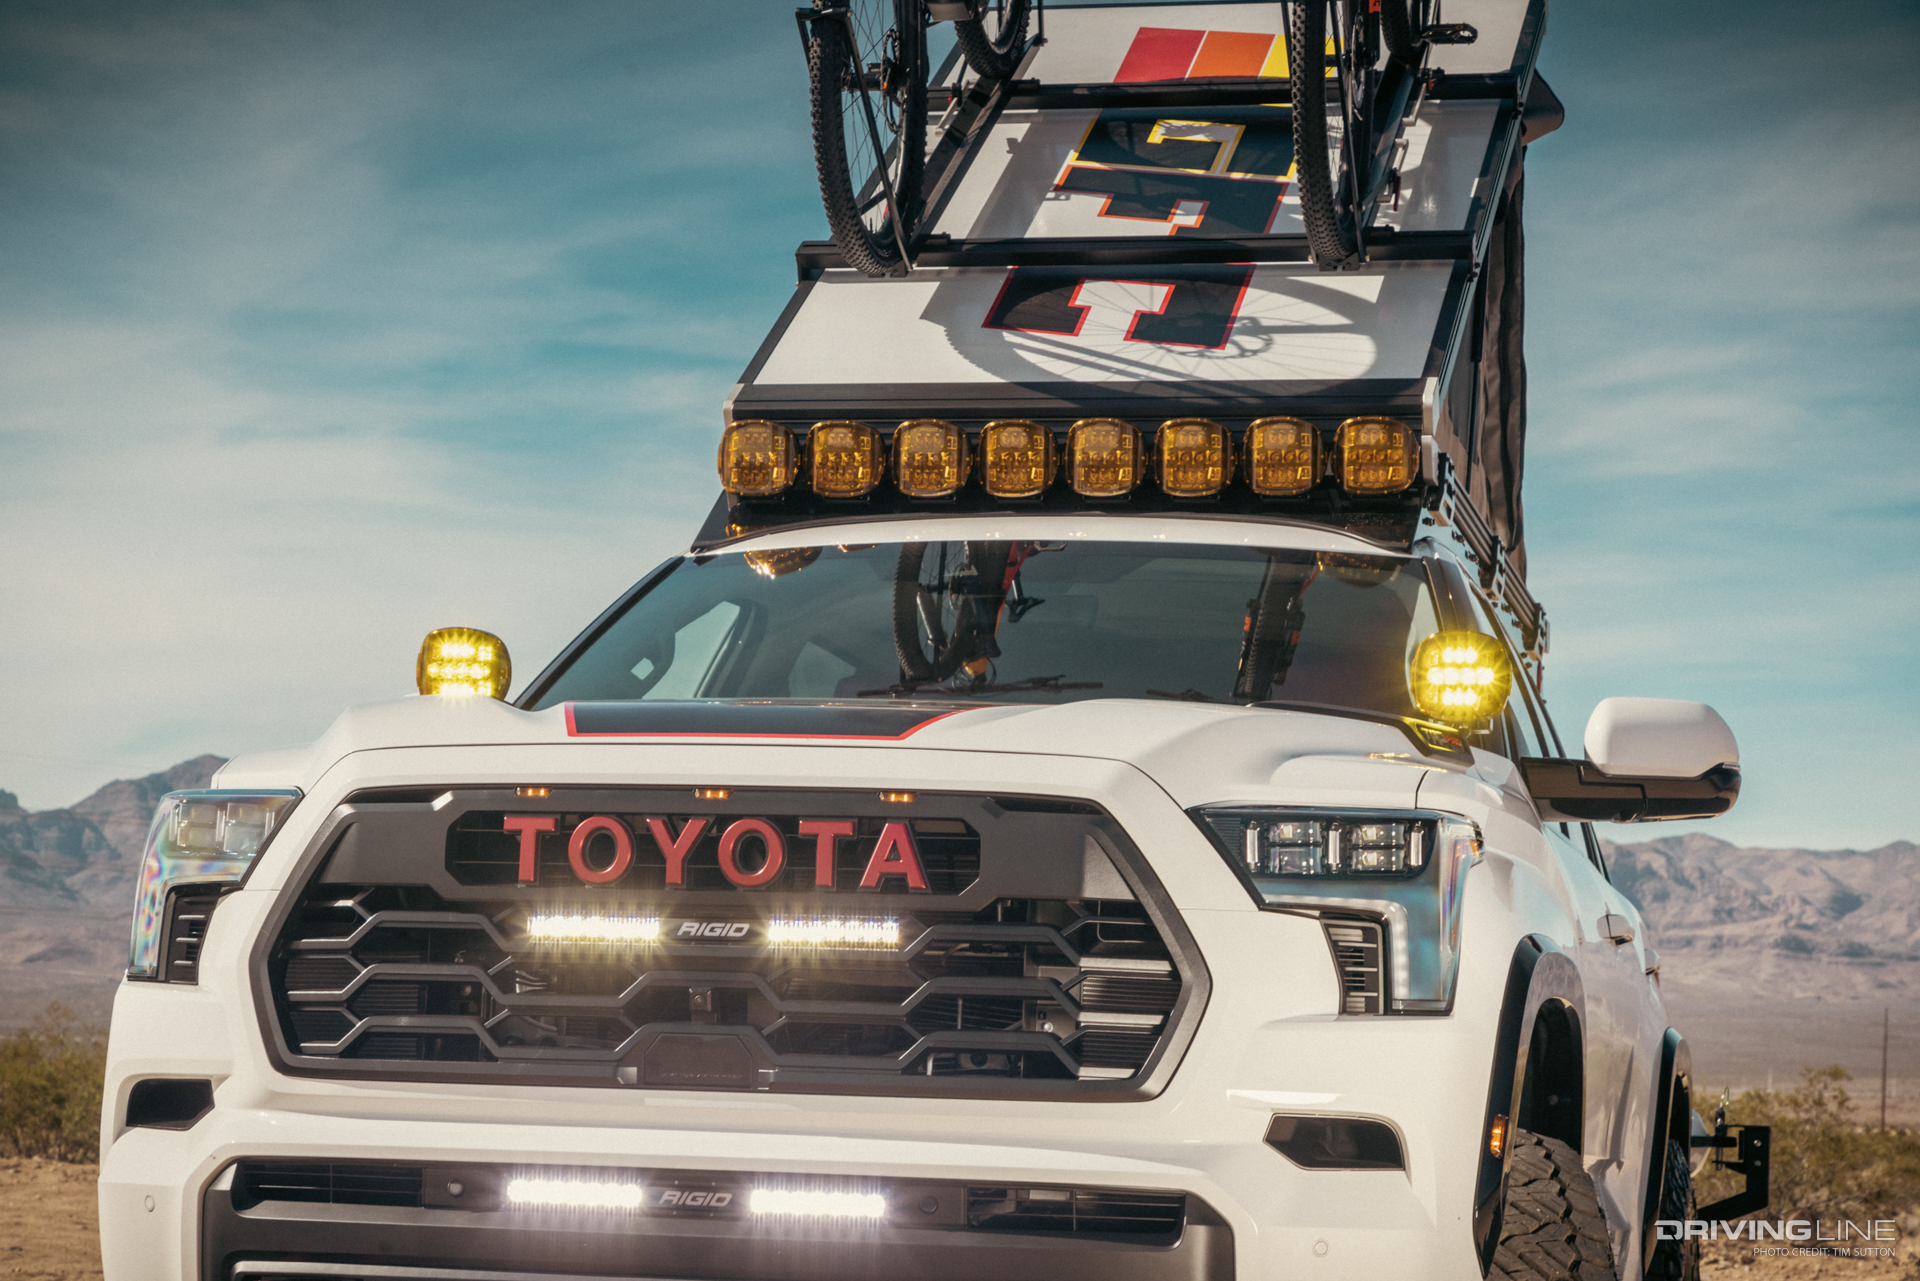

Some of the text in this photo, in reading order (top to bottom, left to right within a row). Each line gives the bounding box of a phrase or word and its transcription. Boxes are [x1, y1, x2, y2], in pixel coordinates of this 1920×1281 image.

[502, 814, 930, 890] TOYOTA
[676, 922, 751, 938] RIGID
[658, 1190, 733, 1208] RIGID
